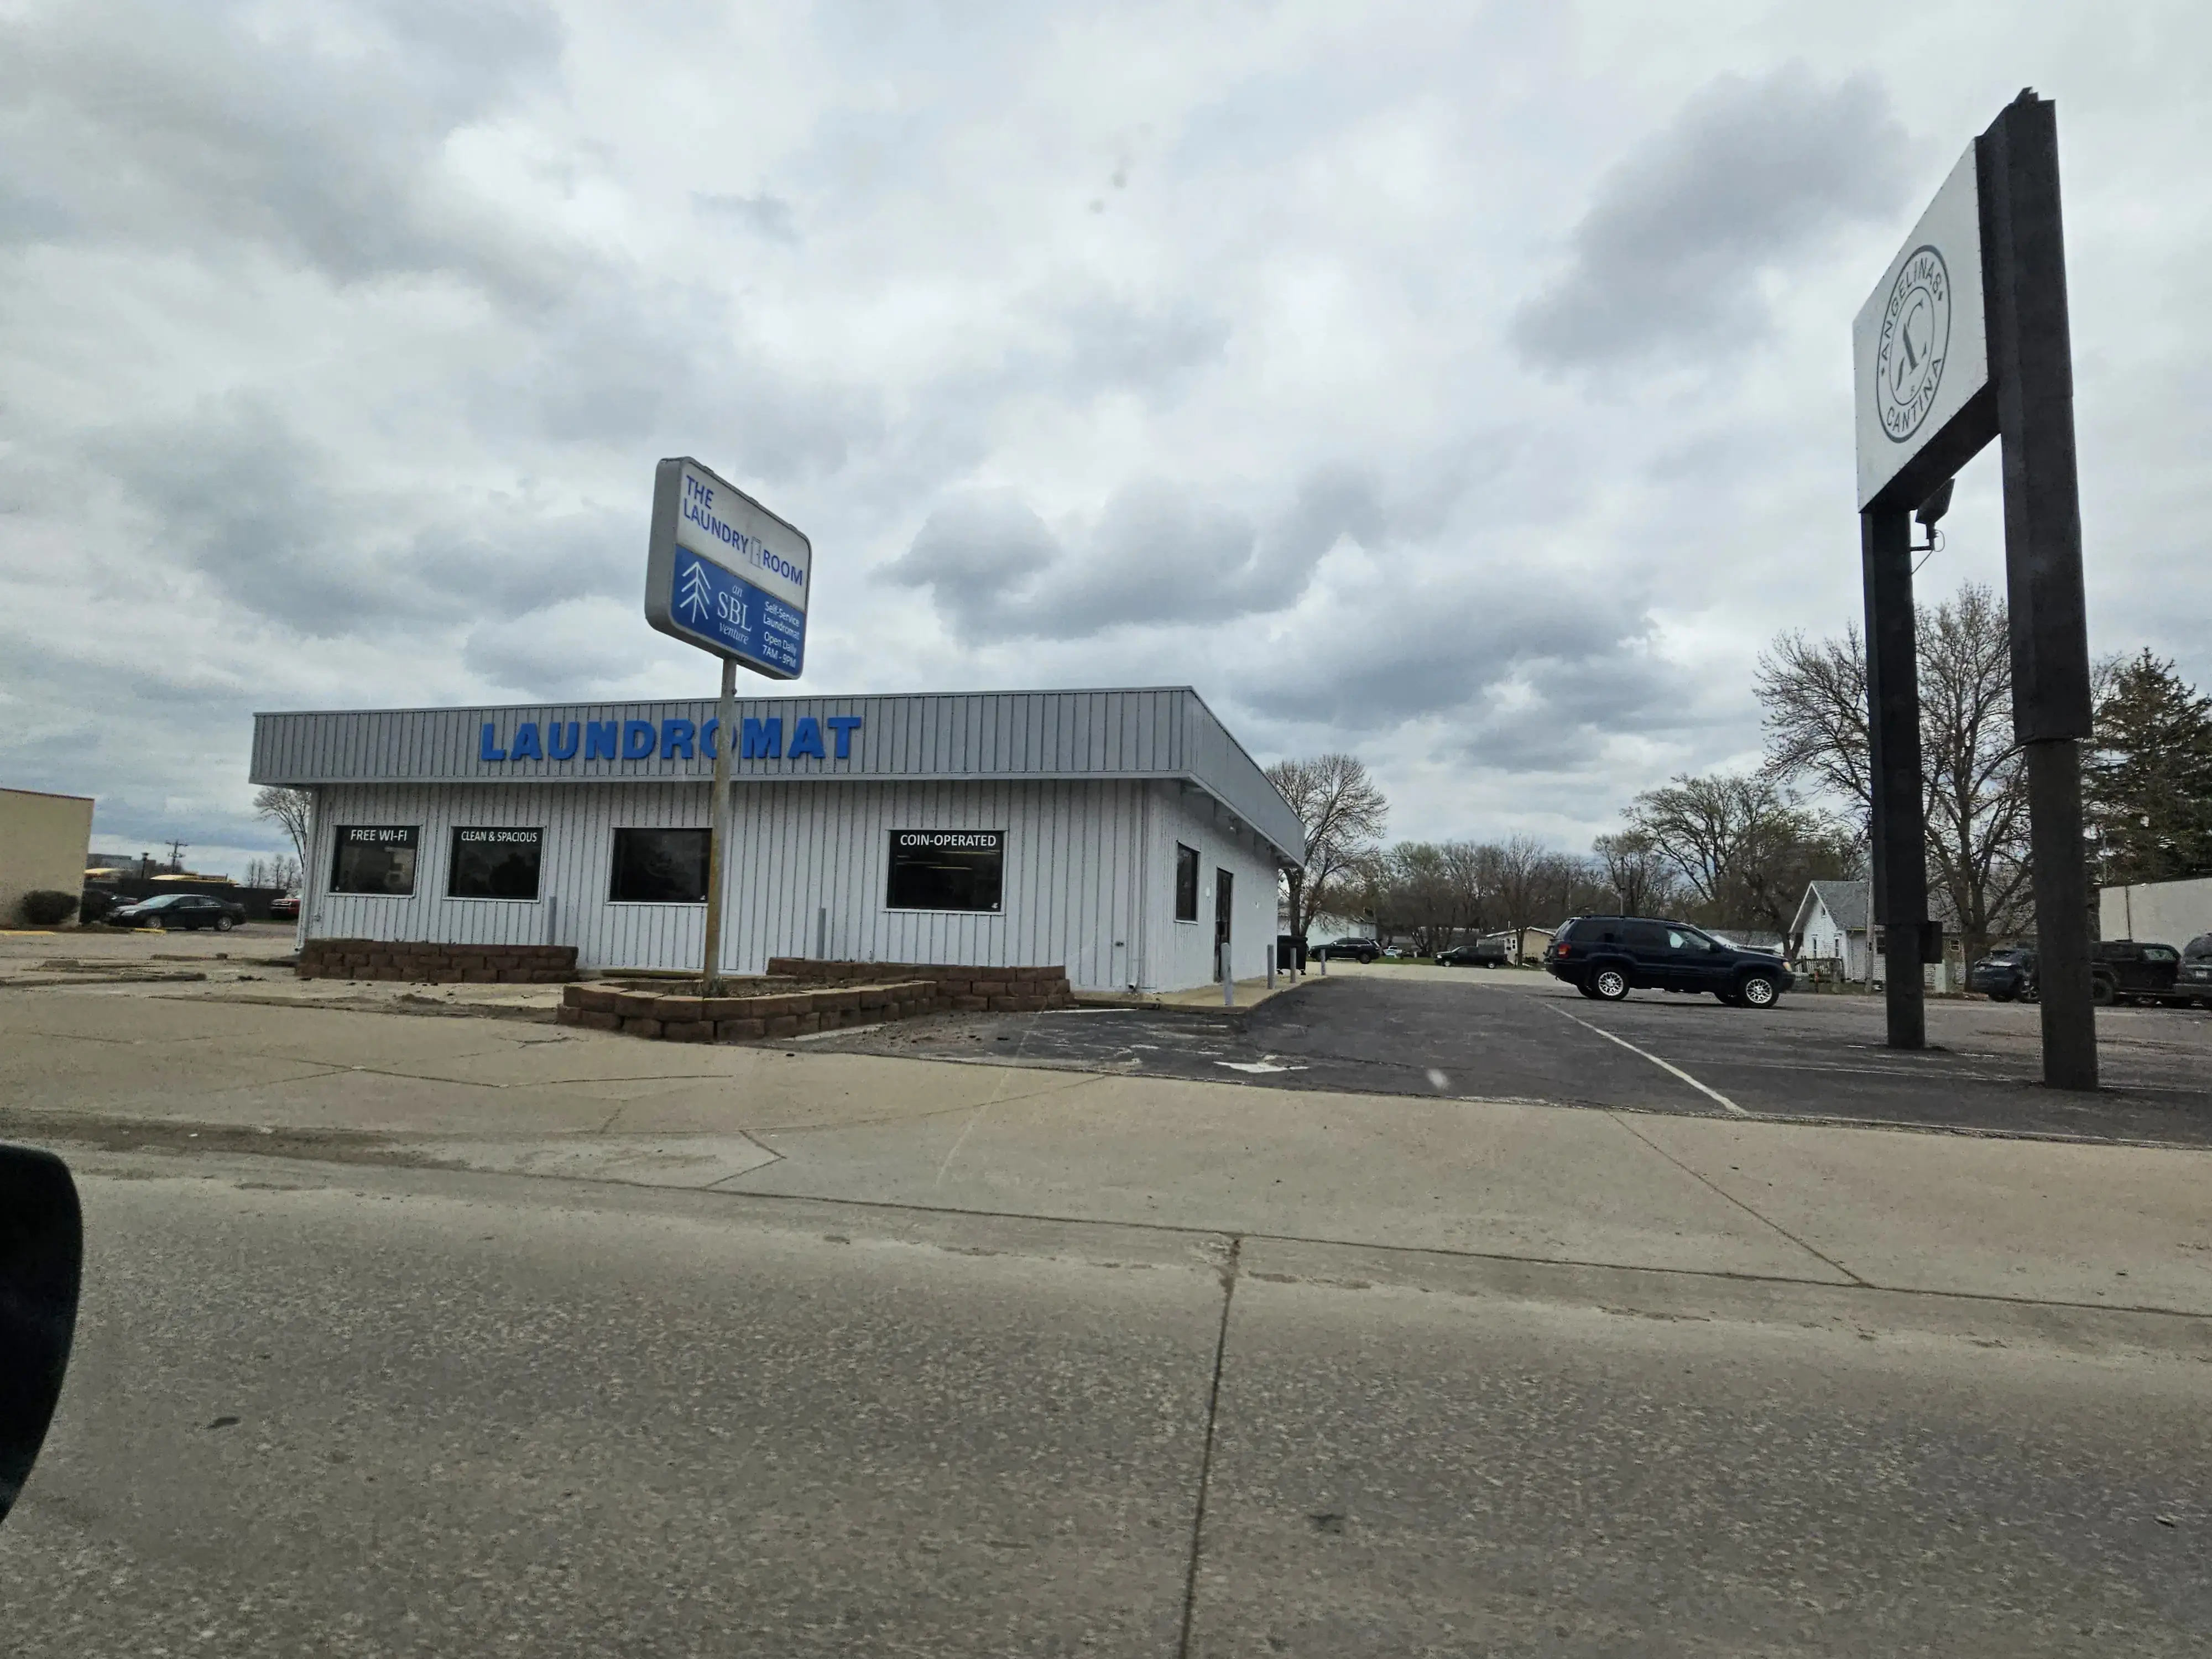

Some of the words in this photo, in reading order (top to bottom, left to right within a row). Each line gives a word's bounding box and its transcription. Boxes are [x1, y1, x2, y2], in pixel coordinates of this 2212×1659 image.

[1886, 358, 1943, 432] CANTINA
[686, 475, 713, 509] THE
[683, 499, 749, 554] LAUNDRY
[763, 549, 804, 586] ROOM
[732, 585, 743, 597] an
[717, 591, 752, 632] SBL
[765, 601, 800, 627] Self-Service
[719, 622, 749, 645] venture
[763, 613, 800, 640] Laundromat
[763, 645, 778, 660] 7AM
[782, 654, 796, 668] 9PM
[764, 632, 781, 648] Open
[782, 640, 797, 657] Daily
[480, 716, 862, 761] LAUNDROMAT
[350, 830, 375, 842] FREE
[379, 830, 408, 842] WI-FI
[461, 831, 487, 842] CLEAN
[489, 832, 495, 842] &
[497, 832, 538, 843] SPACIOUS
[900, 834, 997, 847] COIN-OPERATED
